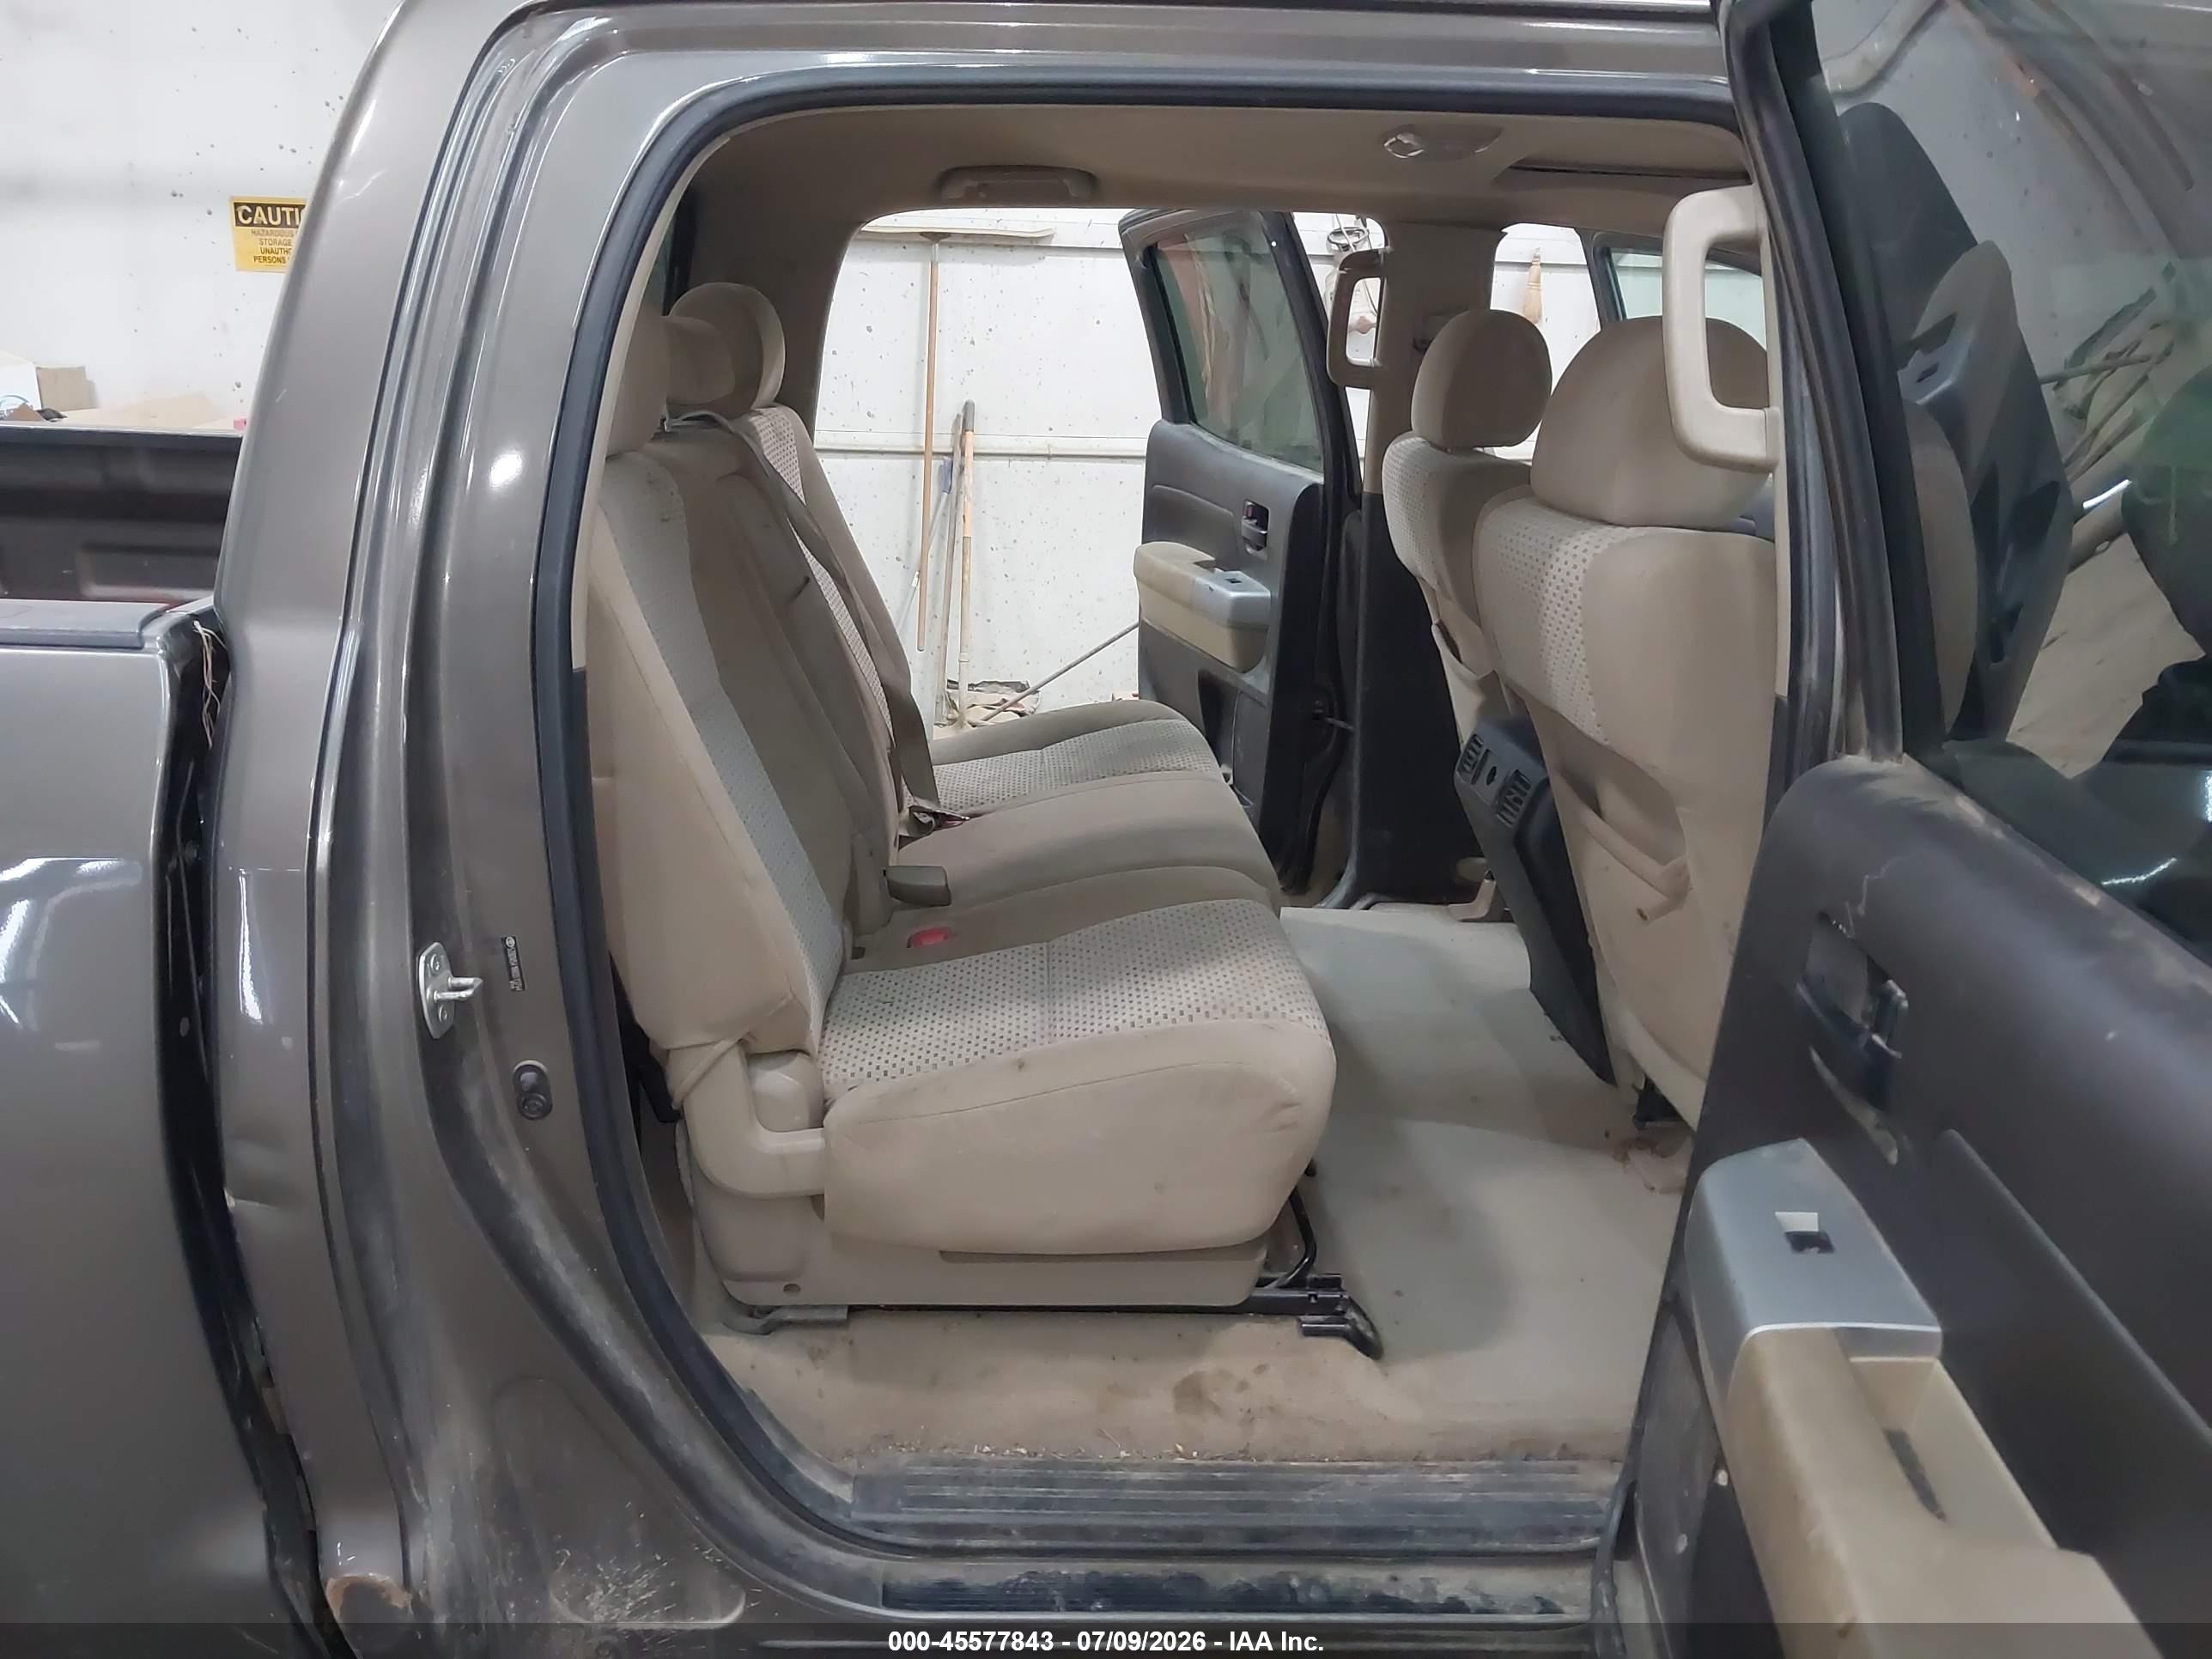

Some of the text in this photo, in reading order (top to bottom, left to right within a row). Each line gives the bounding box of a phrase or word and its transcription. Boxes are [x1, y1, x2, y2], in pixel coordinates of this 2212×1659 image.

[236, 205, 305, 226] CAUTI
[251, 228, 294, 237] HAZARDOUS
[259, 238, 293, 246] STORAGE
